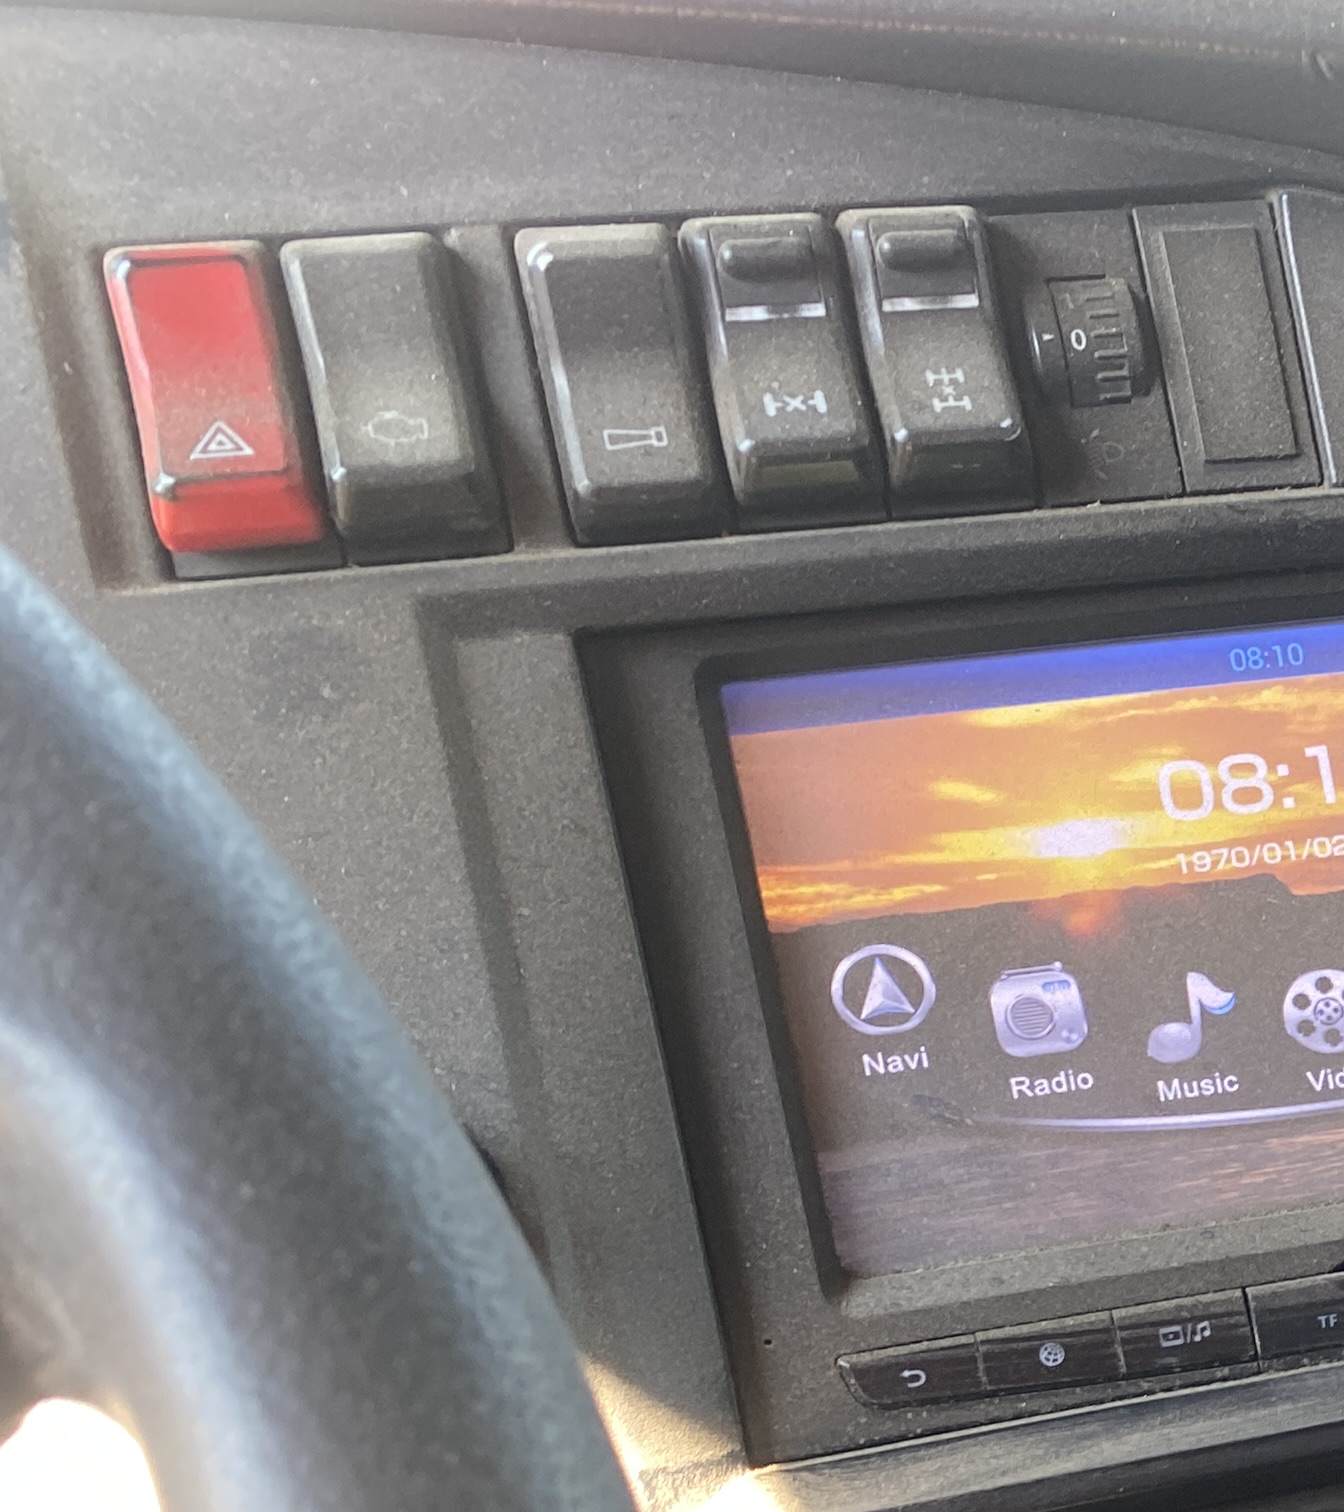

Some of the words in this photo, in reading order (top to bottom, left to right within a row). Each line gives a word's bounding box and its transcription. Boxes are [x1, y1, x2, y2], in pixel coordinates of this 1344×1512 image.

[1229, 642, 1304, 672] 08:10
[861, 1046, 930, 1077] Navi
[1009, 1069, 1094, 1099] Radio
[1156, 1072, 1240, 1103] Music
[1317, 1313, 1339, 1329] TF
